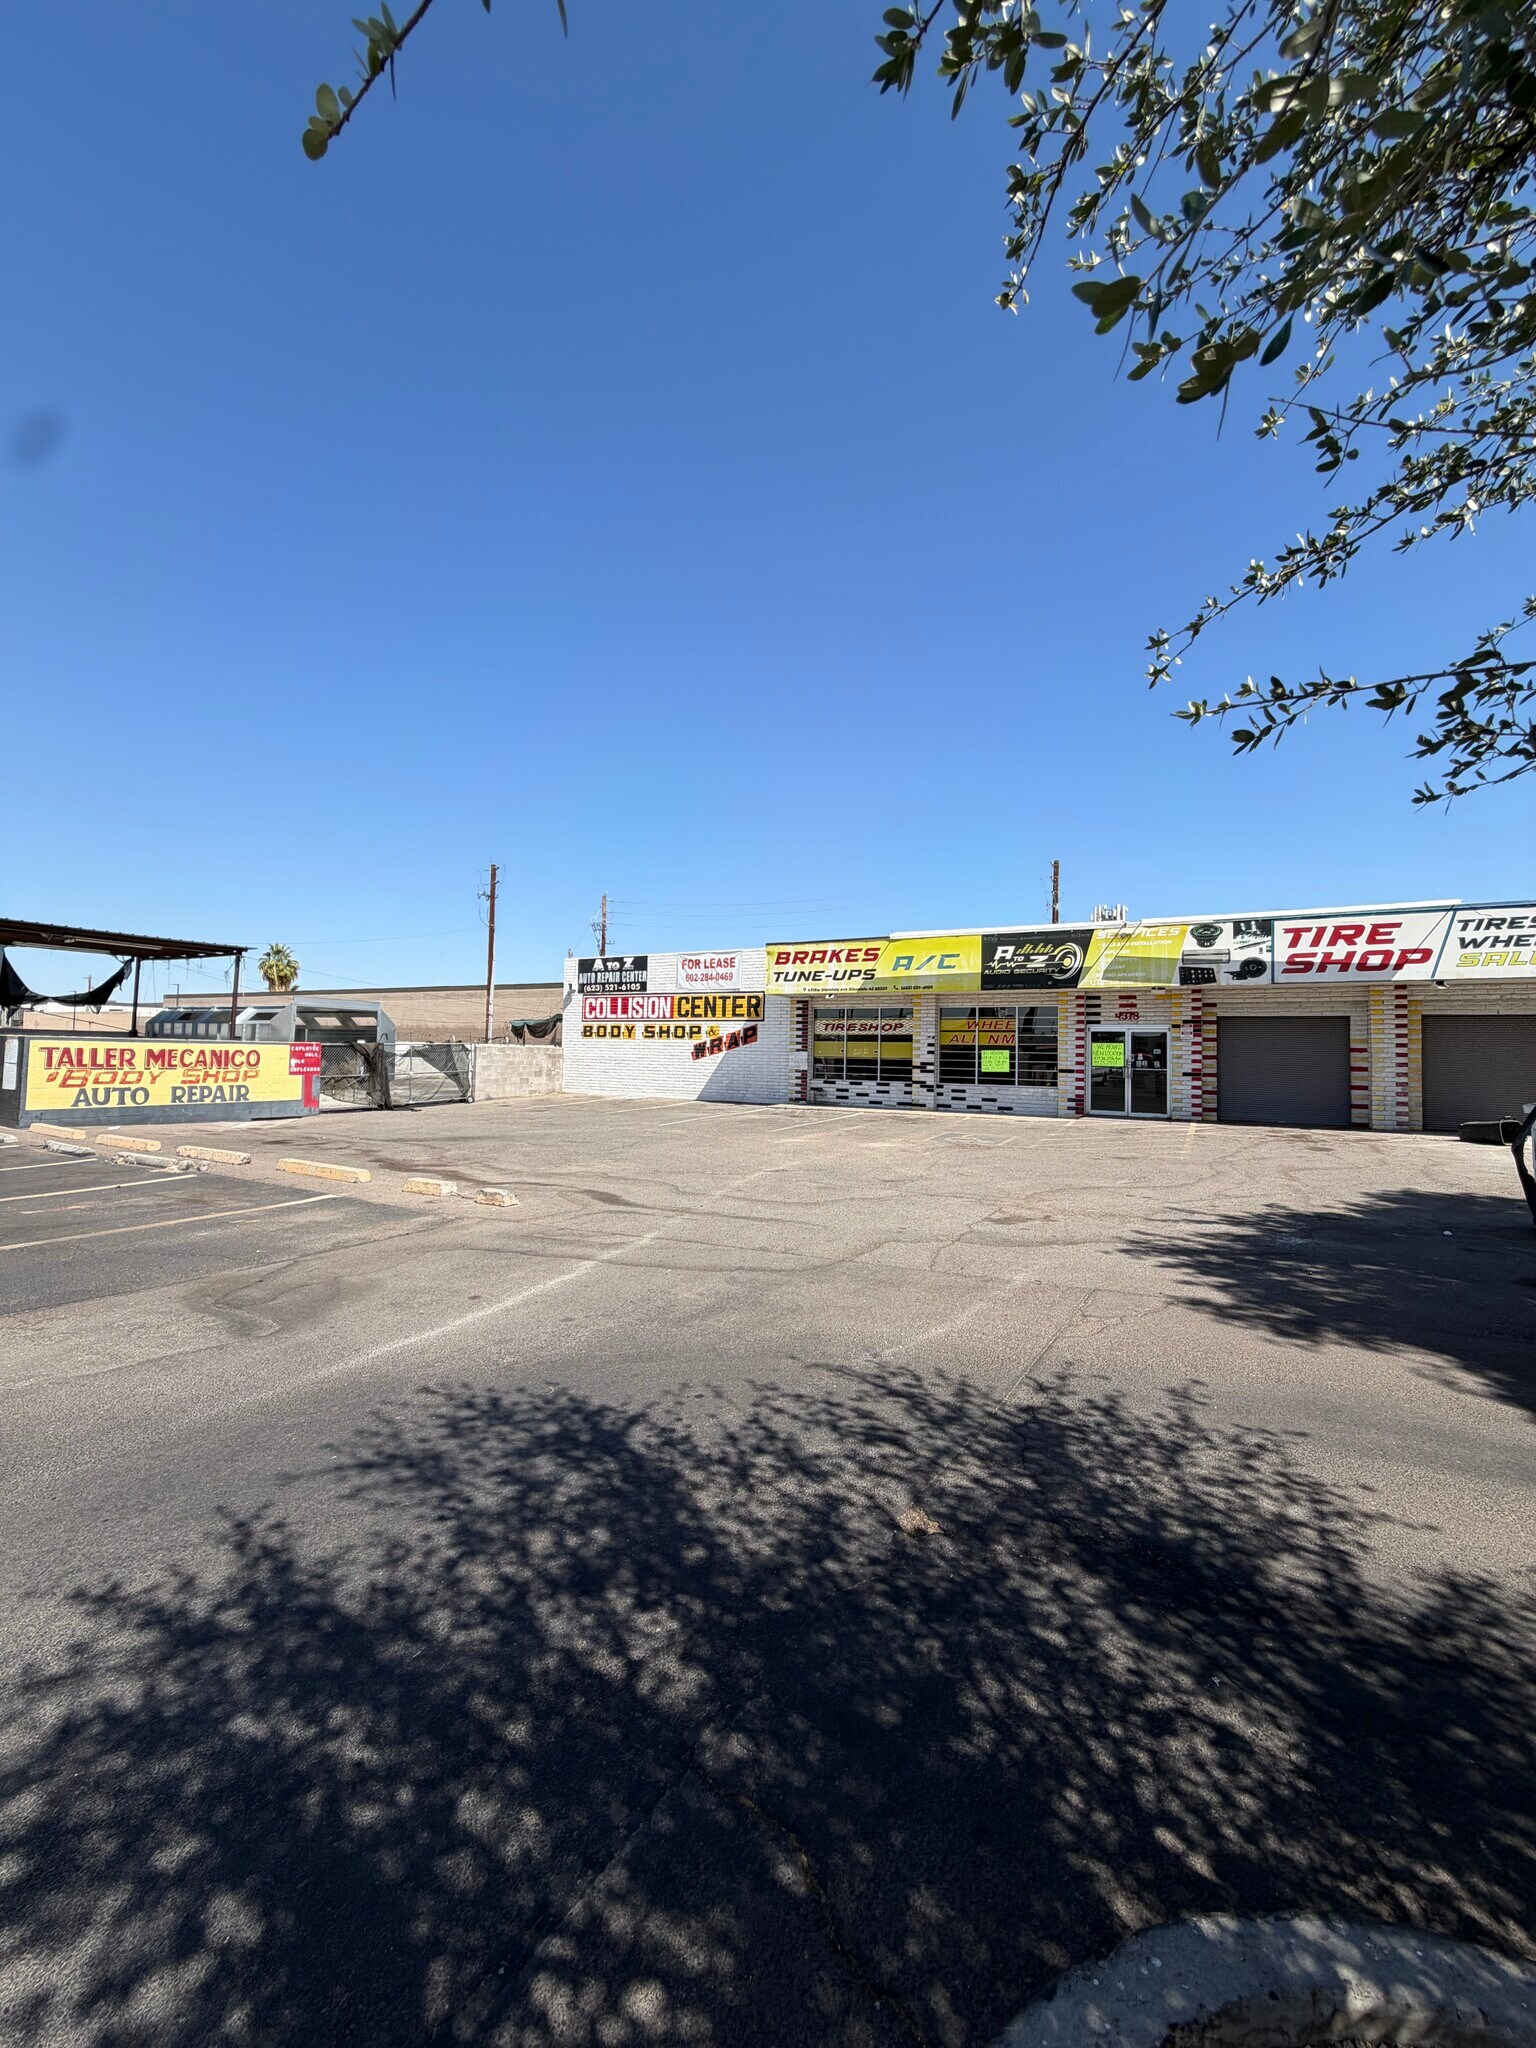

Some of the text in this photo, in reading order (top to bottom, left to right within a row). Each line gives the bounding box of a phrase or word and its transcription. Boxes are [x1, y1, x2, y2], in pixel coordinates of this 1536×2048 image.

[1282, 922, 1403, 948] TIRE
[1457, 934, 1536, 949] WHE
[592, 958, 604, 971] A
[622, 957, 635, 970] Z
[681, 957, 736, 970] FOR LEASE
[774, 947, 881, 966] BRAKES
[892, 953, 960, 971] A/C
[994, 946, 1016, 960] A
[1026, 955, 1049, 967] Z
[1281, 947, 1434, 974] SHOP
[579, 970, 647, 984] AUTO REPAIR CENTER
[685, 971, 734, 982] 602-284-0469
[773, 968, 877, 983] TUNE-UPS
[584, 983, 641, 993] (623) 521-6105
[585, 995, 762, 1019] COLLISION CENTER
[582, 1025, 720, 1039] BODY SHOP &
[691, 1024, 758, 1060] WRAP
[38, 1046, 137, 1070] TALLER
[144, 1047, 261, 1070] MECANICO
[57, 1068, 260, 1089] BODY SHOP
[71, 1085, 250, 1107] AUTO REPAIR
